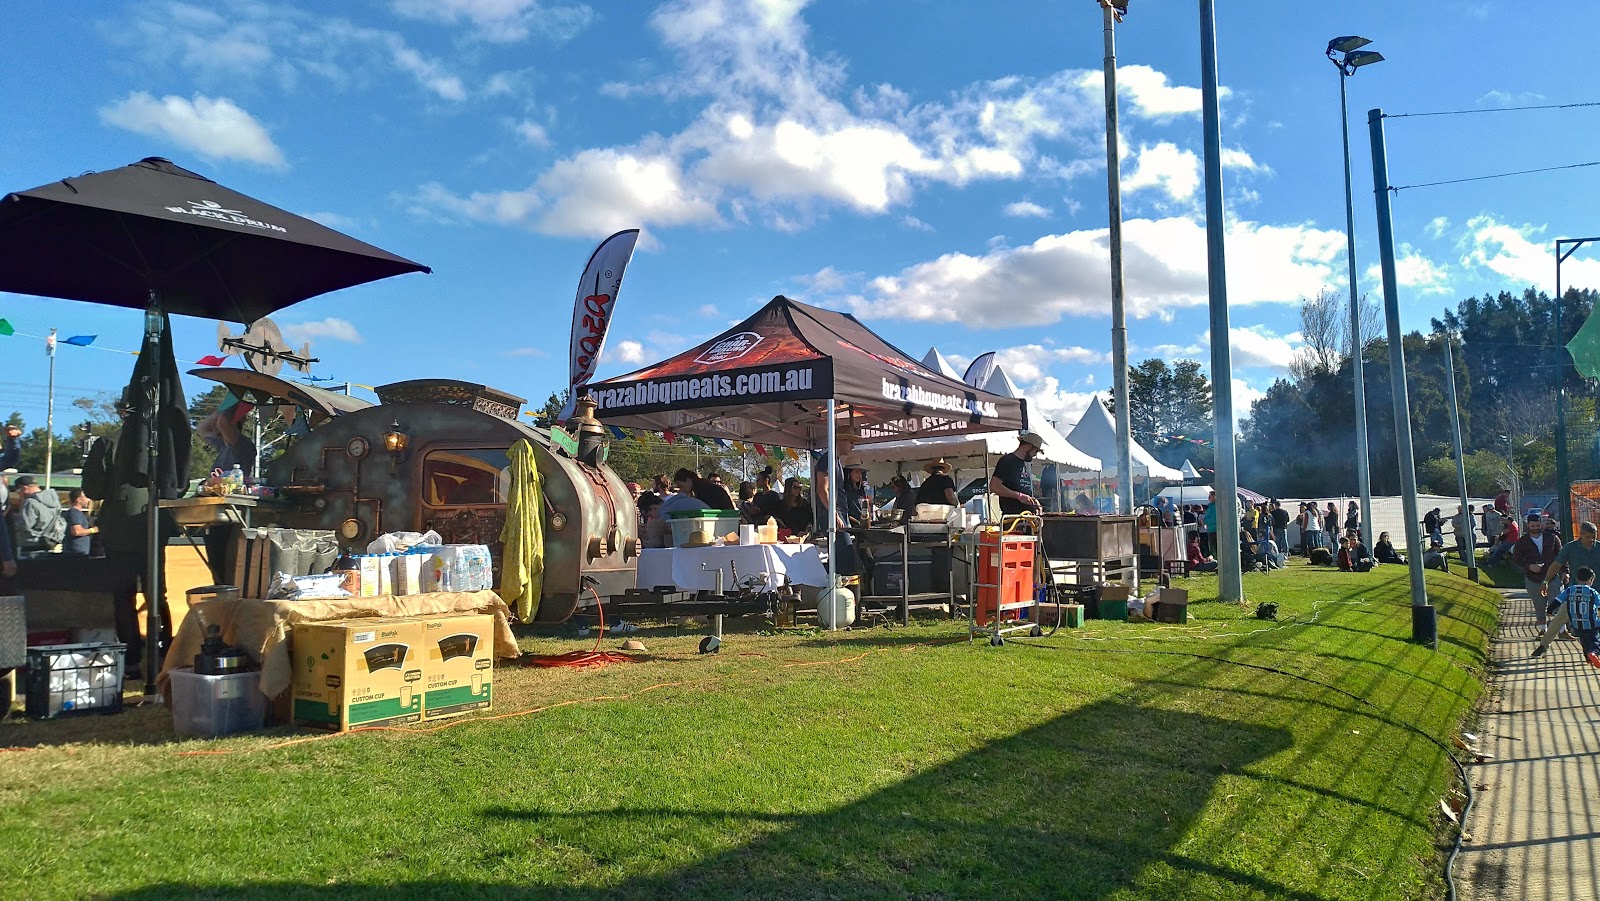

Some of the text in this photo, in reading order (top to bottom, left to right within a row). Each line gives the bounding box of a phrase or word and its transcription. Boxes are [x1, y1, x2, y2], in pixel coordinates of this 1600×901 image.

[165, 207, 229, 220] BLACK
[230, 216, 287, 233] DRUM
[588, 368, 813, 410] brazabbqmeats.com.au
[881, 377, 999, 418] brazabbqmeats.com.au
[1571, 601, 1588, 615] 10
[427, 681, 447, 689] CUSTOM
[351, 693, 385, 703] CUSTOM CUP
